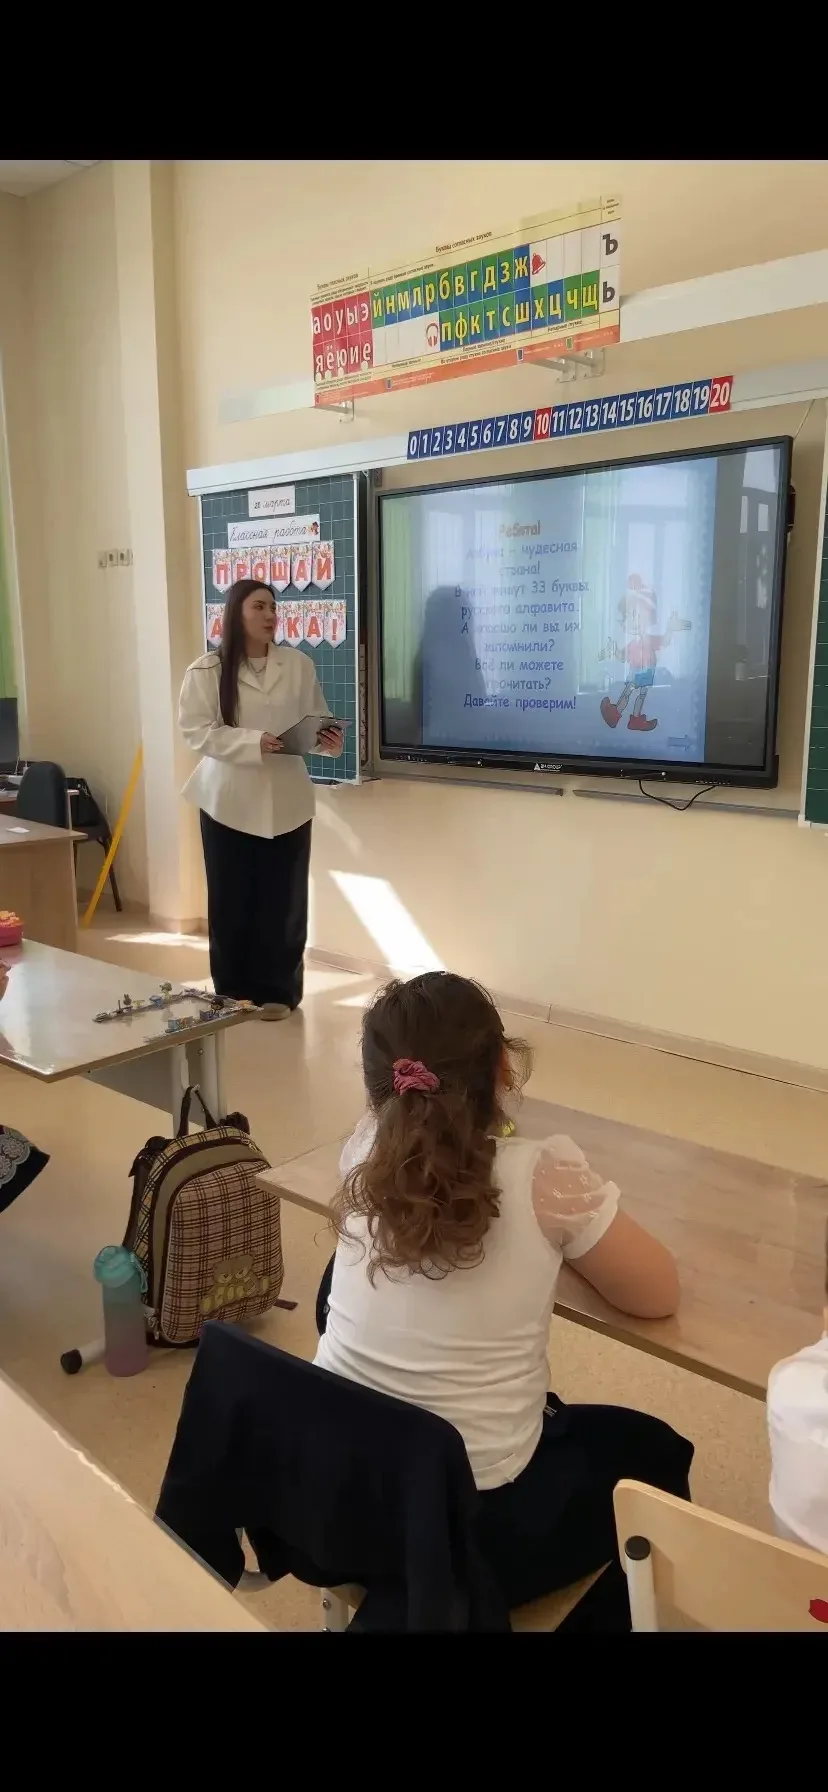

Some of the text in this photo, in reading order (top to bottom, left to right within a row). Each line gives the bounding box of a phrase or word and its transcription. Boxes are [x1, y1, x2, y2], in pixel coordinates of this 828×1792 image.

[410, 382, 730, 455] 0 1 2 3 4 5 6 7 8 9 10 11 12 13 14 15 16 17 18 19 20
[230, 520, 306, 543] Классная работа
[521, 542, 577, 559] чудесная
[216, 552, 332, 585] ПРОЩАЙ
[531, 581, 545, 594] 33
[461, 622, 469, 634] А
[522, 623, 537, 632] ли
[543, 623, 559, 632] вы
[565, 622, 580, 632] их
[500, 661, 514, 671] ли
[519, 661, 564, 671] можете
[515, 696, 577, 712] проверим!
